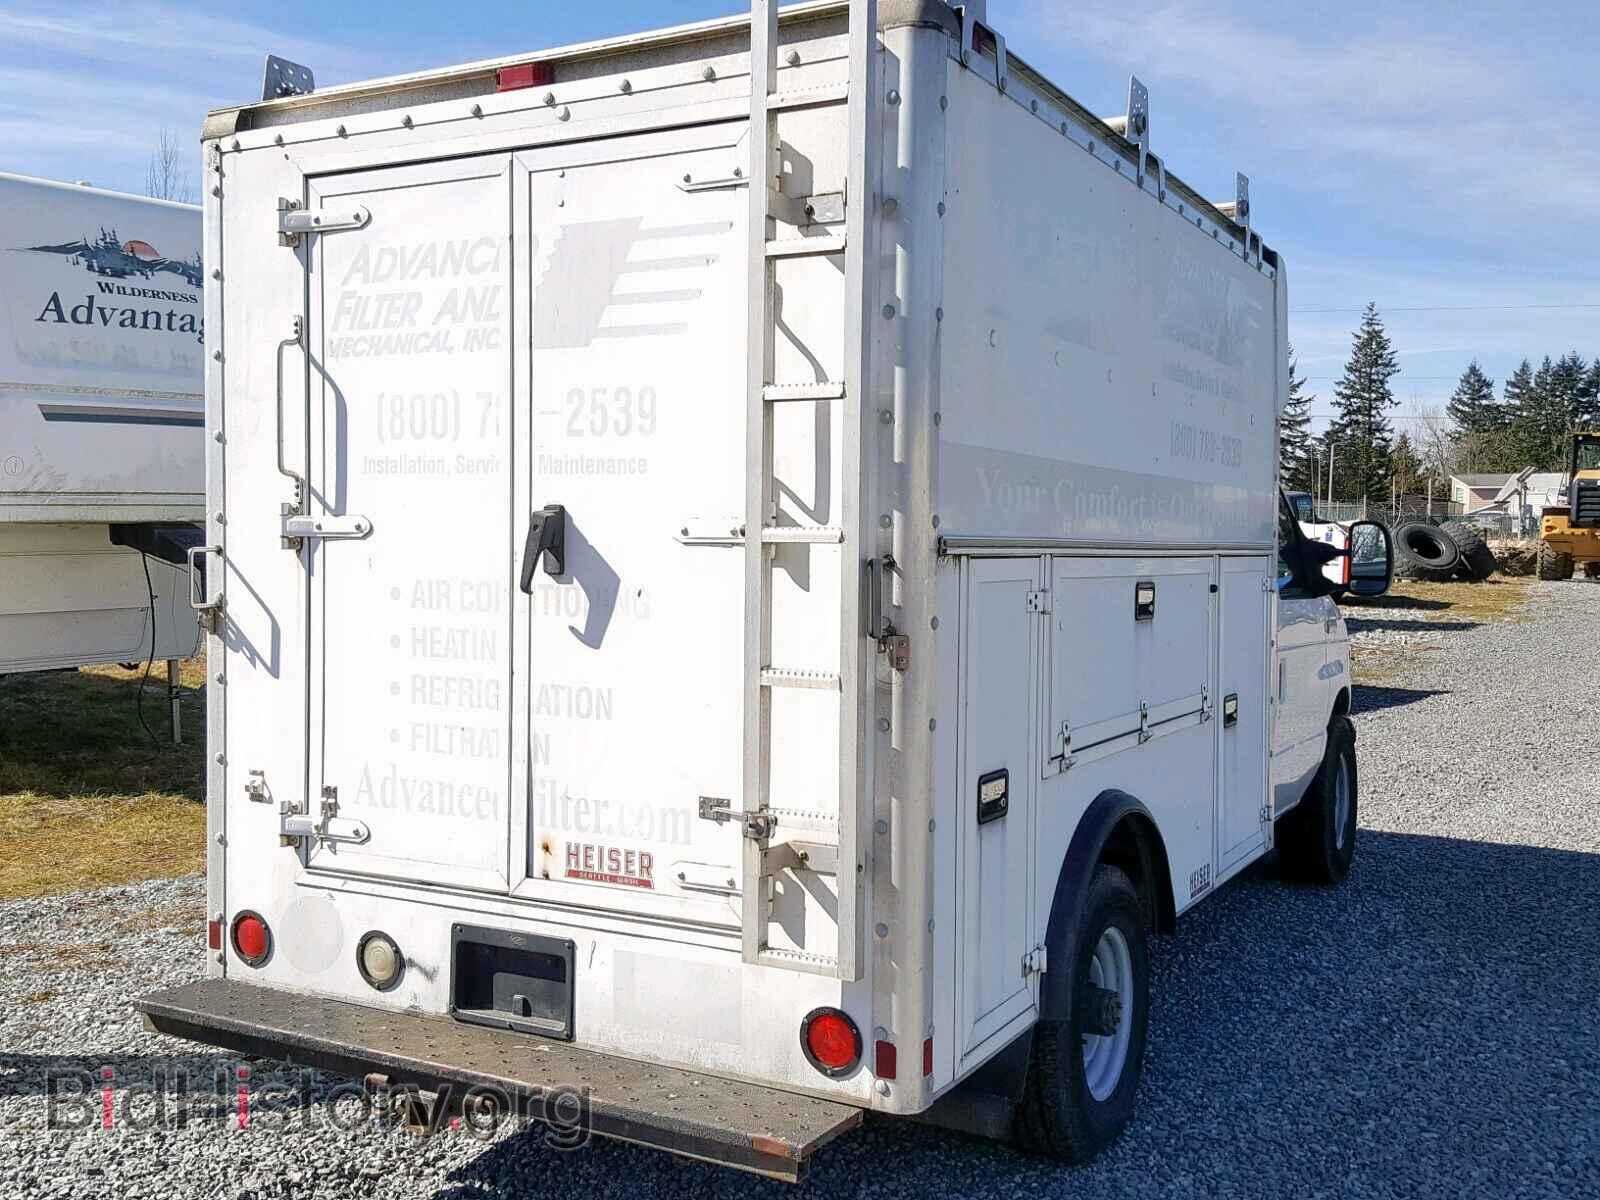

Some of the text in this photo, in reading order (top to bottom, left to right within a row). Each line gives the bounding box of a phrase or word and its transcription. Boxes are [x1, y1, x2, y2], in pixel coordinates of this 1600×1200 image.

[340, 236, 503, 286] ADVANC
[97, 280, 199, 304] WILDERNESS
[332, 289, 423, 332] FILTER
[35, 291, 205, 344] Advanta
[327, 330, 455, 359] MECHANICAL,
[376, 387, 461, 444] (800)
[362, 453, 452, 478] Installation,
[538, 453, 649, 476] Maintenance
[974, 464, 1048, 514] Your
[410, 579, 451, 611] AIR
[410, 627, 498, 661] HEATIN
[565, 841, 654, 879] HEISER
